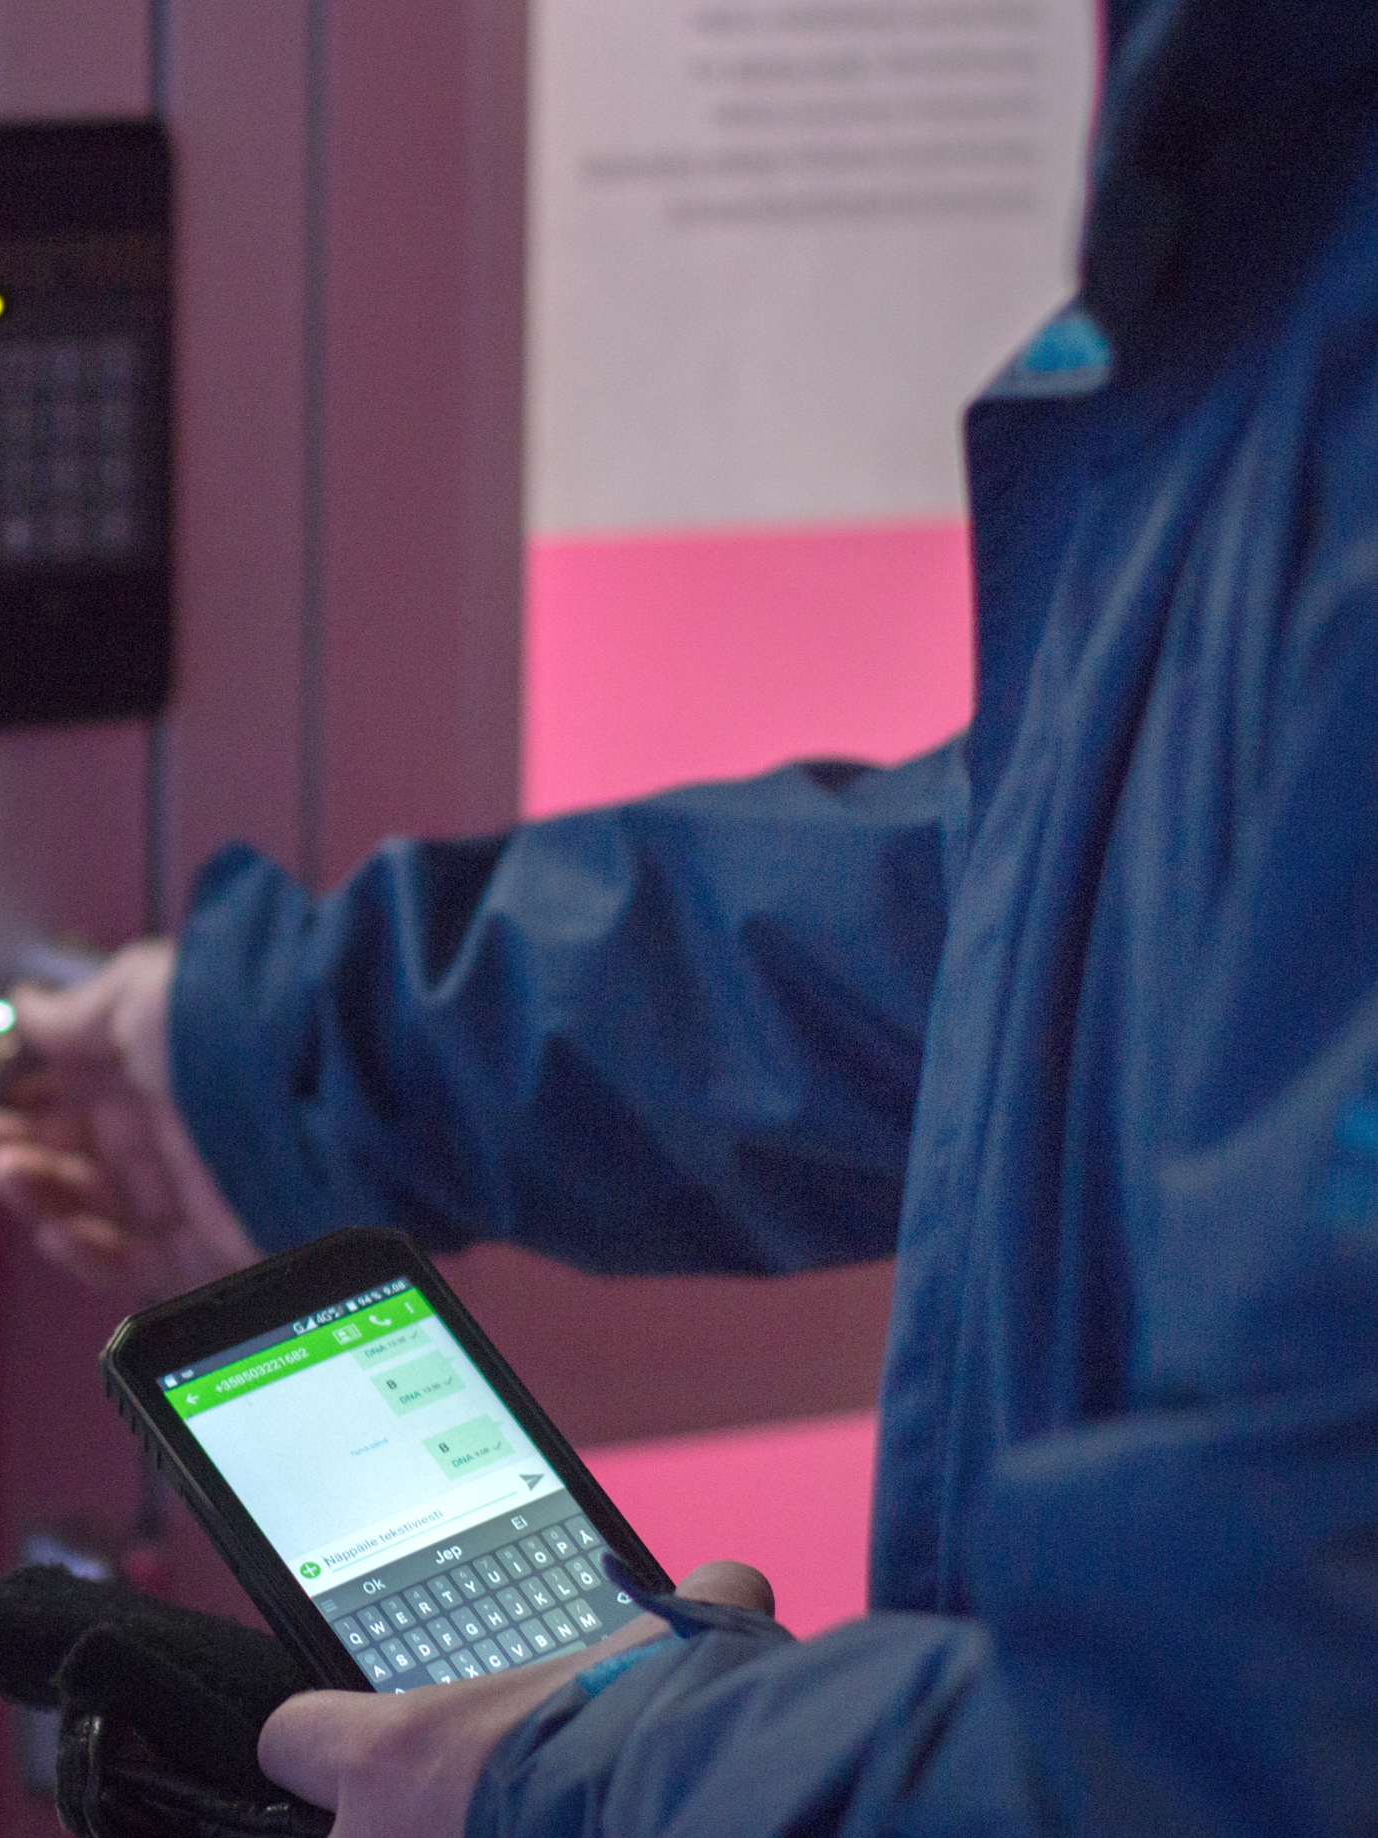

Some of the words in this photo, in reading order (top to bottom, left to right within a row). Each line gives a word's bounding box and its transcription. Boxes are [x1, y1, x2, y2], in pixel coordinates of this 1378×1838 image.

[364, 1344, 387, 1358] DNA
[386, 1379, 397, 1390] B
[399, 1390, 422, 1404] DNA
[439, 1442, 450, 1453] B
[451, 1454, 474, 1468] DNA
[326, 1536, 379, 1567] Näppäile
[379, 1509, 444, 1543] tekstiviesti
[362, 1577, 386, 1595] Ok
[436, 1545, 463, 1565] Jep
[349, 1632, 363, 1645] Q
[370, 1620, 386, 1636] W
[395, 1611, 408, 1625] E
[418, 1601, 432, 1615] R
[441, 1590, 453, 1603] T
[464, 1581, 476, 1593] Y
[487, 1570, 500, 1583] U
[513, 1561, 522, 1573] I
[534, 1551, 547, 1564] O
[557, 1541, 568, 1554] P
[374, 1664, 386, 1678] A
[395, 1654, 408, 1667] S
[418, 1643, 431, 1657] D
[441, 1632, 452, 1646] F
[465, 1622, 478, 1635] G
[488, 1612, 502, 1626] H
[515, 1602, 523, 1615] J
[534, 1592, 548, 1605] K
[557, 1584, 571, 1596] L
[464, 1664, 478, 1678] X
[488, 1655, 501, 1667] C
[510, 1643, 523, 1657] V
[534, 1634, 547, 1648] B
[557, 1623, 571, 1638] N
[579, 1613, 596, 1628] M
